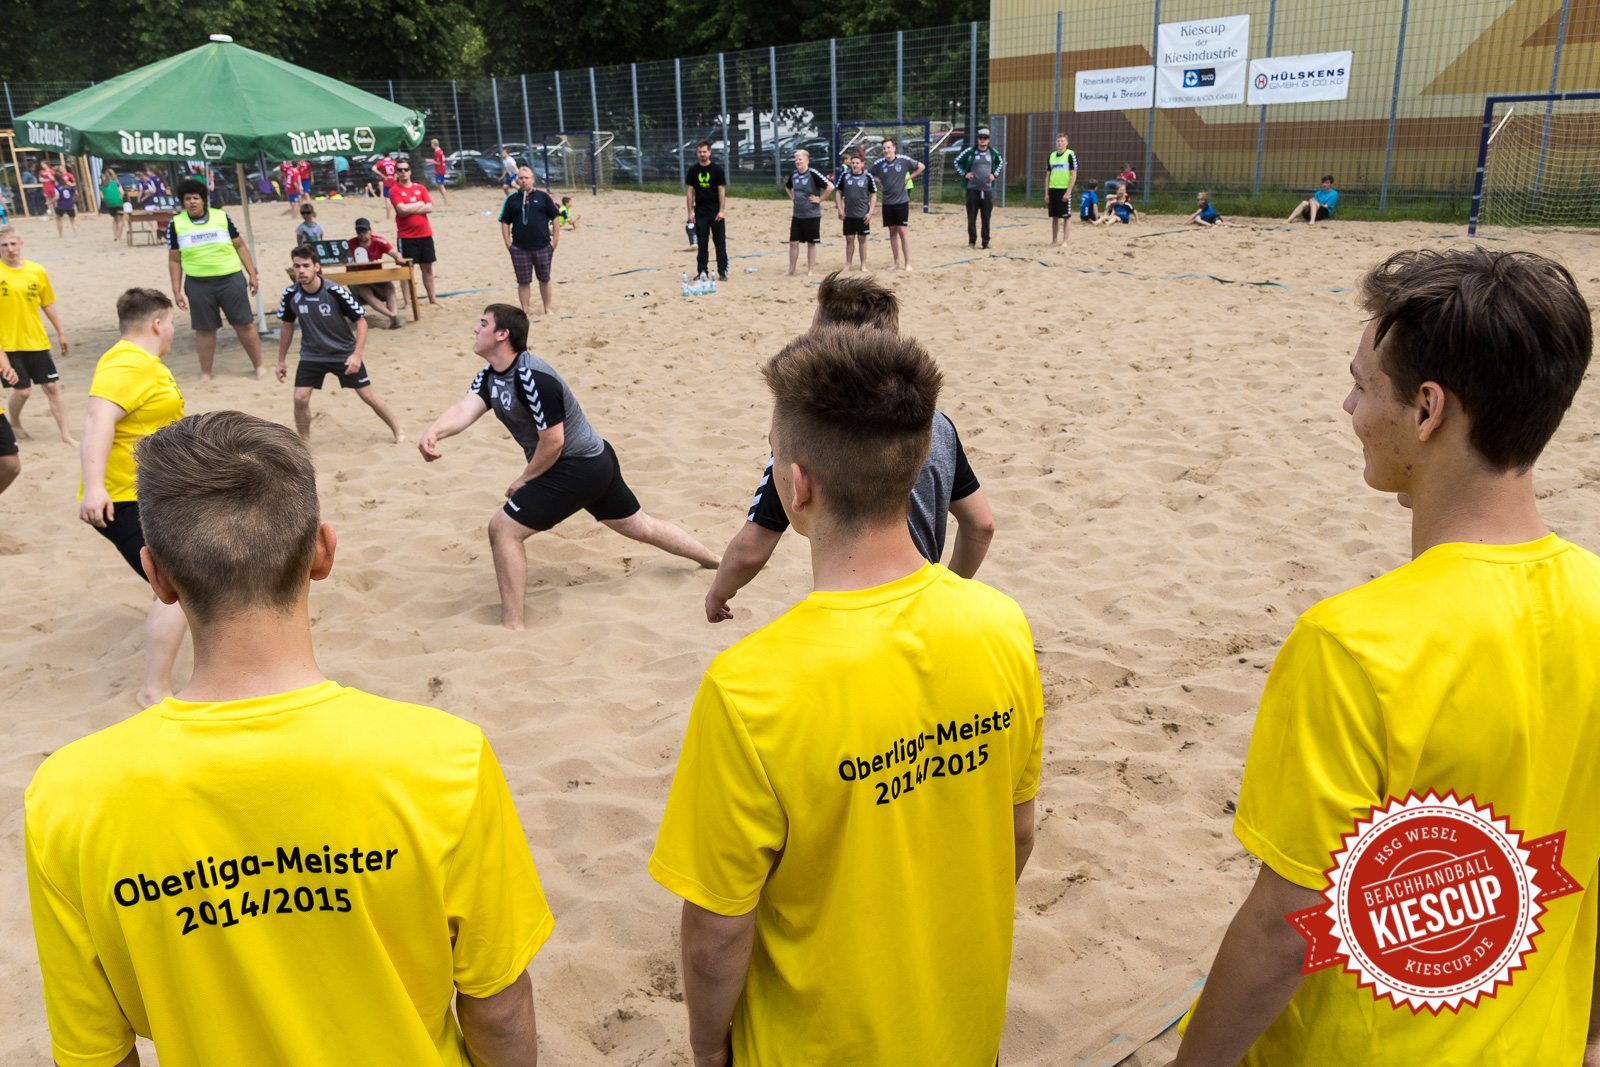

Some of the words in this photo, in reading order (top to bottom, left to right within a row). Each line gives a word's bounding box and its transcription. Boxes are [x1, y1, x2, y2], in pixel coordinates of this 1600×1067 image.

[1181, 24, 1226, 37] Kiescup
[1195, 39, 1208, 47] der
[1165, 47, 1239, 64] Kiesindustrie
[1271, 68, 1345, 81] HÜLSKENS
[1269, 81, 1299, 90] GMBH
[1301, 80, 1309, 88] &
[1120, 89, 1147, 99] Bresser
[118, 129, 197, 157] Diebels
[287, 128, 352, 155] Diebels
[316, 244, 326, 257] 6
[331, 244, 340, 256] 5
[875, 743, 988, 806] 2014/2015
[113, 844, 399, 907] Oberliga-Meister
[176, 886, 352, 936] 2014/2015
